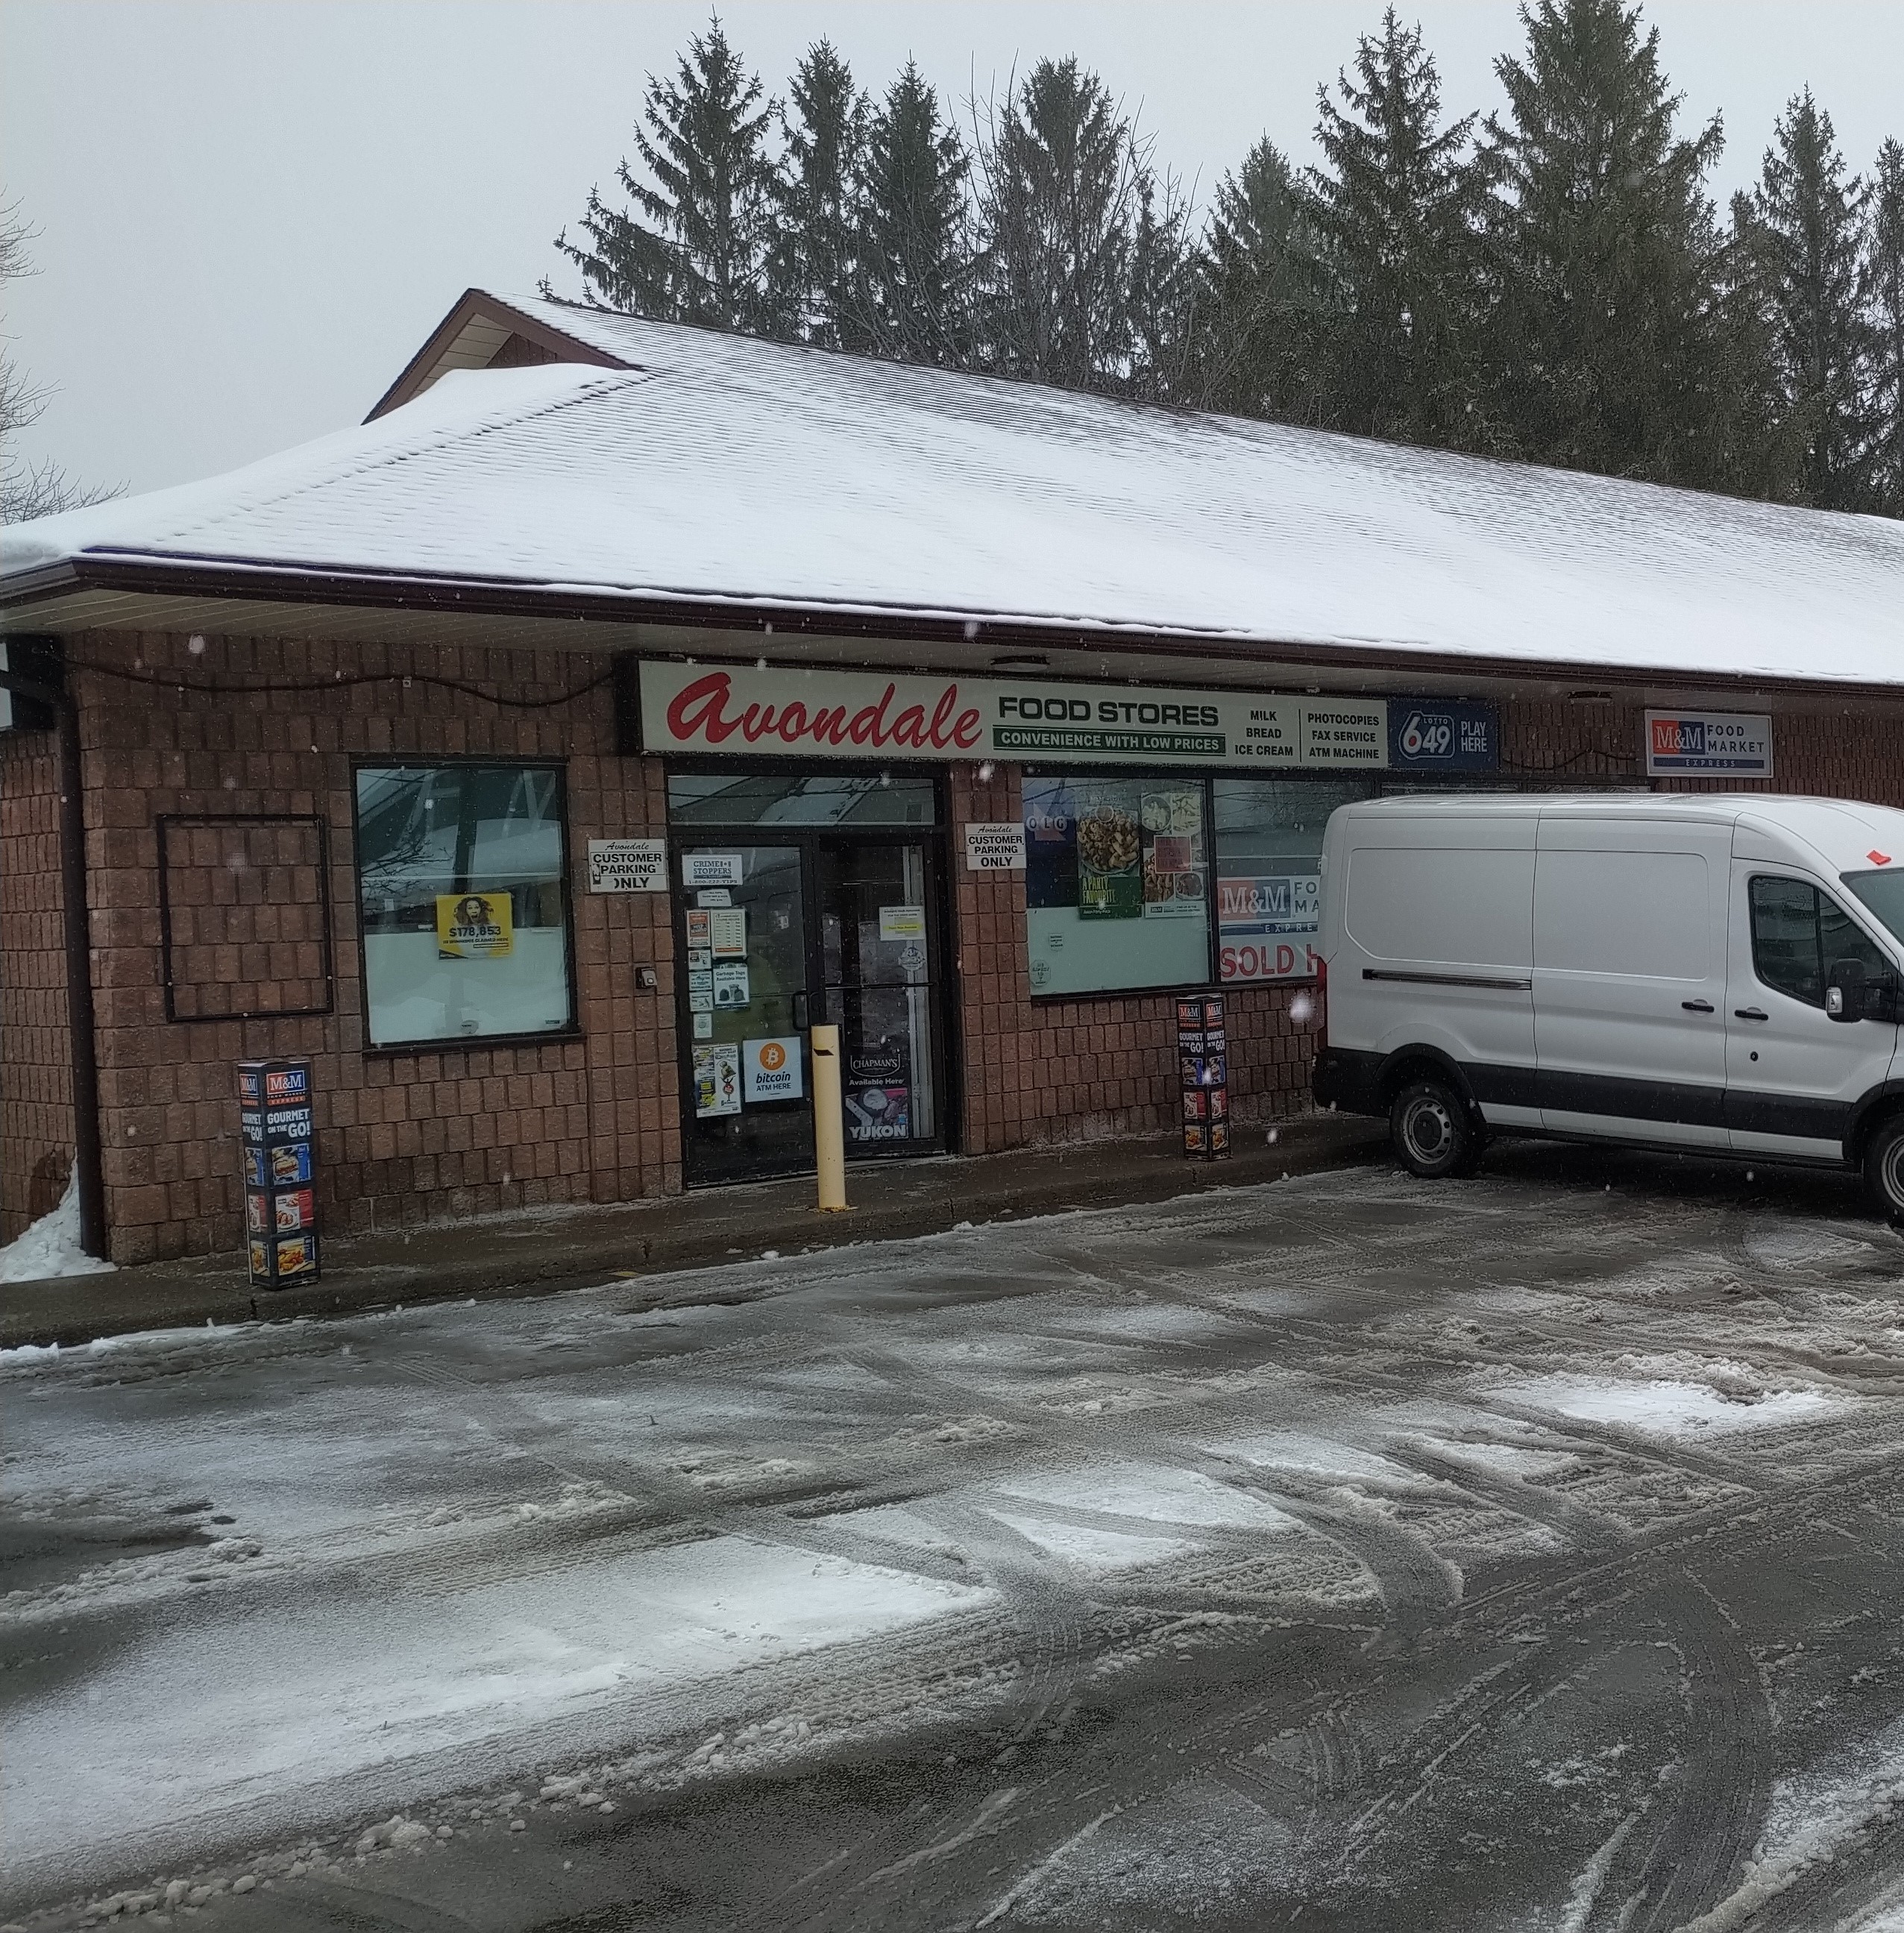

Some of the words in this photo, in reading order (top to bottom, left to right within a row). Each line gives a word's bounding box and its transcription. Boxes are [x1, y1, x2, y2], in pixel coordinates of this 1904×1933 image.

[667, 672, 983, 749] Avondale
[999, 697, 1091, 721] FOOD
[1098, 701, 1219, 726] STORES
[1250, 711, 1277, 721] MILK
[1307, 713, 1380, 726] PHOTOCOPIES
[1245, 727, 1282, 739] BREAD
[1460, 720, 1486, 737] PLAY
[1706, 724, 1744, 737] FOOD
[1001, 732, 1102, 748] CONVENIENCE
[1105, 735, 1140, 749] WITH
[1143, 736, 1171, 749] LOW
[1174, 737, 1219, 750] PRICES
[1311, 729, 1332, 741] FAX
[1333, 731, 1377, 743] SERVICE
[1655, 726, 1703, 749] M&M
[1234, 744, 1254, 755] ICE
[1254, 745, 1294, 756] CREAM
[1460, 737, 1488, 753] HERE
[1707, 741, 1765, 753] MARKET
[1308, 747, 1331, 758] ATM
[1333, 748, 1380, 759] MACHINE
[1685, 758, 1735, 767] EXPRESS
[1028, 817, 1066, 830] OLG
[977, 826, 1013, 834] Avondale
[605, 841, 650, 851] Avondale
[968, 835, 1023, 845] CUSTOMER
[974, 845, 1018, 855] PARKING
[593, 853, 662, 864] CUSTOMER
[980, 857, 1013, 867] ONLY
[600, 864, 656, 875] PARKING
[1088, 876, 1108, 890] PARTY
[1294, 881, 1317, 895] FO
[1222, 885, 1287, 914] M&M
[449, 925, 501, 937] $178,853
[1265, 923, 1313, 933] EXPRE
[1220, 944, 1295, 978] SOLD
[1180, 1007, 1198, 1017] M&M
[1179, 1032, 1204, 1042] GOURMET
[1190, 1042, 1204, 1054] GO!
[853, 1057, 898, 1069] CHAPMAN'S
[269, 1075, 303, 1091] M&M
[755, 1072, 791, 1084] bitcoin
[755, 1084, 772, 1093] ATM
[773, 1082, 791, 1091] HERE
[267, 1108, 310, 1125] GOURMET
[277, 1124, 288, 1133] THE
[288, 1121, 311, 1138] GO!
[849, 1125, 906, 1139] YUKON
